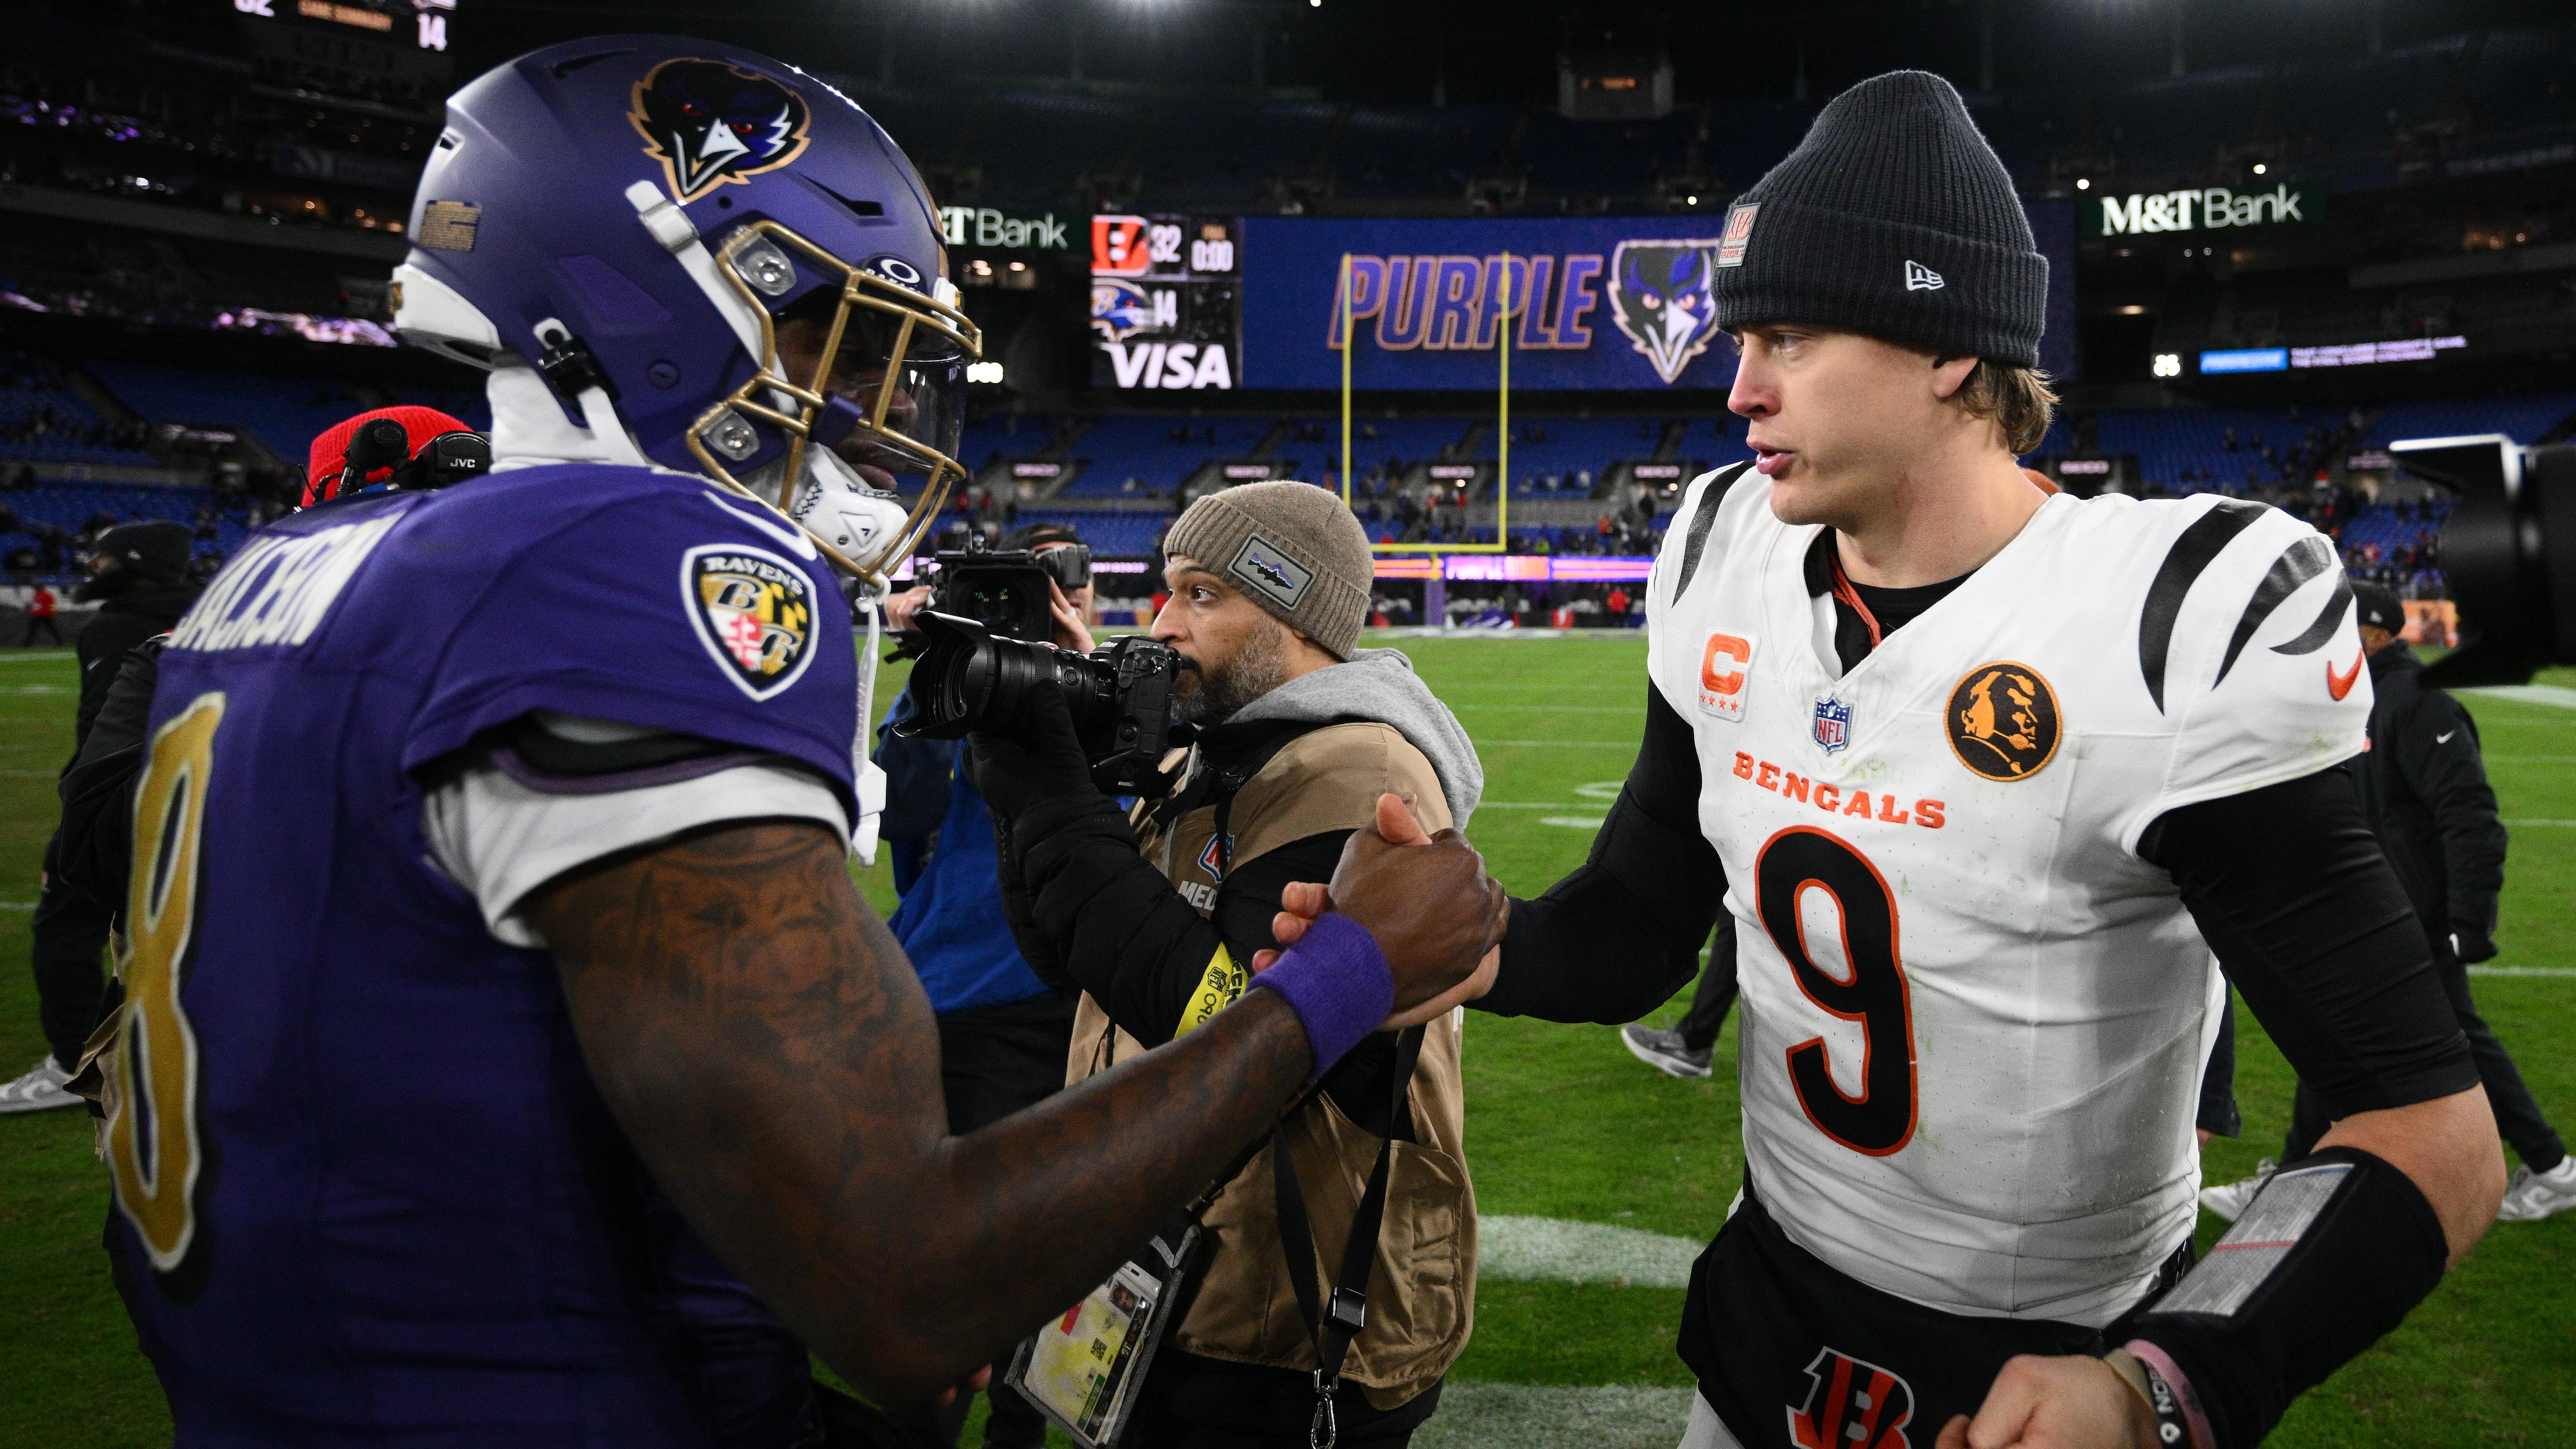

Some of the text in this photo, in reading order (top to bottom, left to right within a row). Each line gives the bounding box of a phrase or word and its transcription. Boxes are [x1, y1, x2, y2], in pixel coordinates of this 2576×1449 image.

[417, 13, 448, 51] 14
[976, 207, 1069, 249] Bank
[2101, 182, 2303, 236] M&T Bank
[1149, 224, 1182, 263] 32
[1191, 240, 1234, 271] 0:00
[1153, 289, 1177, 328] 14
[1327, 254, 1604, 351] PURPLE
[1096, 342, 1232, 389] VISA
[450, 458, 476, 468] JVC
[703, 556, 804, 595] RAVENS
[1702, 633, 1750, 695] C
[1817, 719, 1843, 744] NFL
[1733, 751, 1946, 829] BENGALS
[104, 692, 226, 1272] 8
[1210, 968, 1222, 985] NFL
[1754, 824, 1918, 1157] 9
